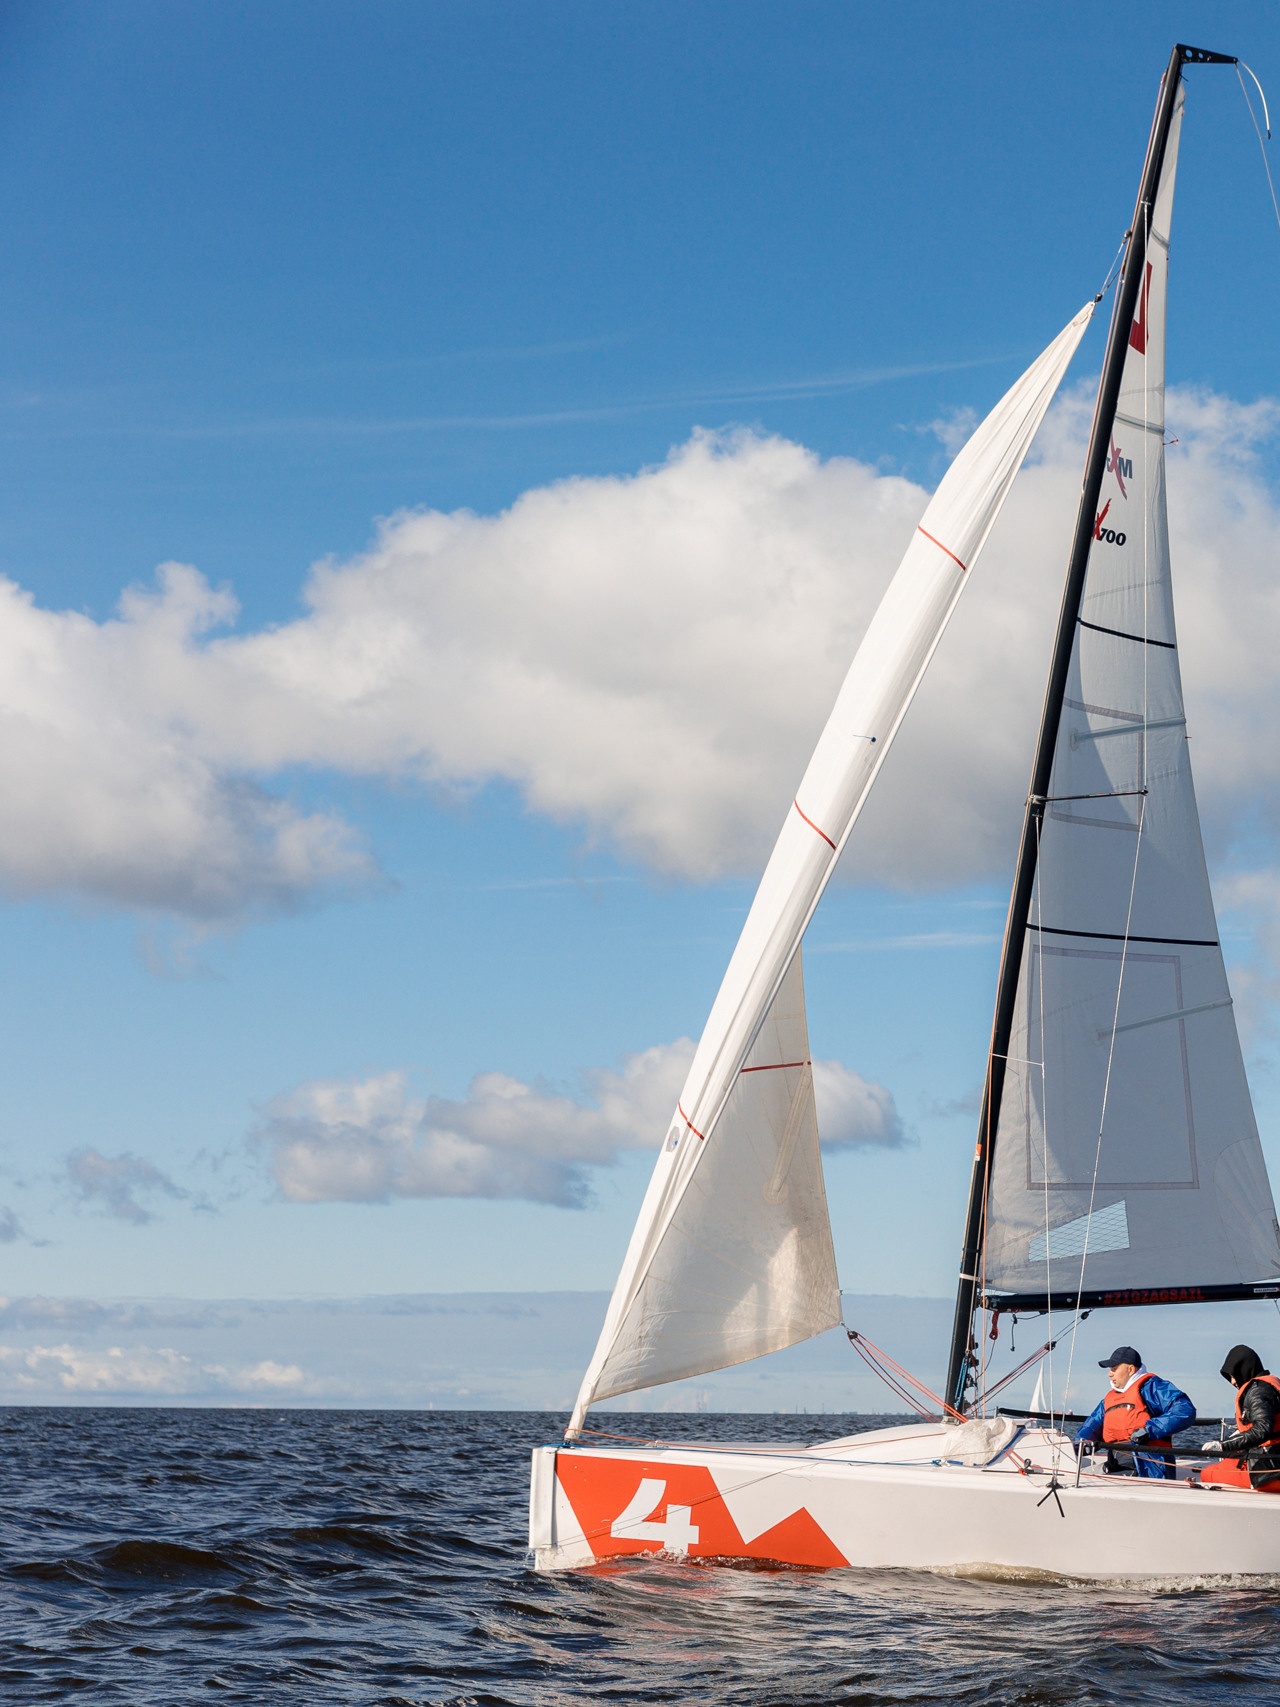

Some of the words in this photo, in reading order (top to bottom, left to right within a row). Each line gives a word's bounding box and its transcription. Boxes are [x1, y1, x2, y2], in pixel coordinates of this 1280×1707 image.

[1092, 498, 1127, 547] X700
[1104, 1288, 1206, 1305] #ZIGZAGSAIL
[610, 1477, 700, 1557] 4
